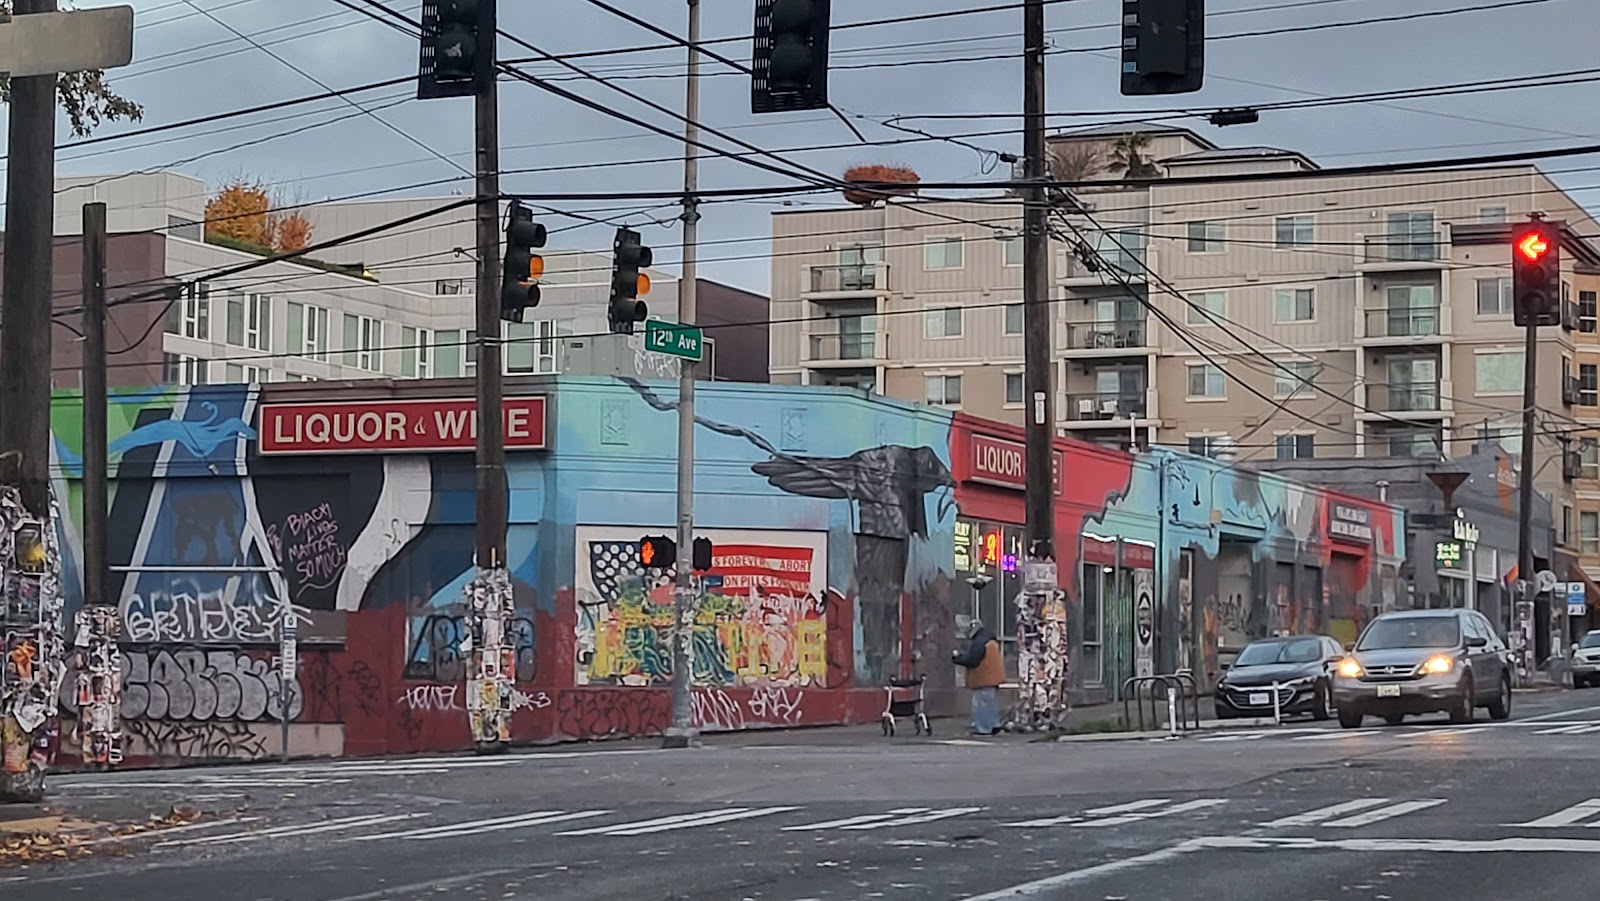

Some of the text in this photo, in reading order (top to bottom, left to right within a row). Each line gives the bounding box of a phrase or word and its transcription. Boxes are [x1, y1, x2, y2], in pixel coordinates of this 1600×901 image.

[652, 327, 697, 350] 12th Ave
[274, 412, 406, 443] LIQUOR
[434, 408, 530, 440] WIE
[976, 444, 1022, 477] LIQUOR
[288, 535, 338, 562] MATTER
[723, 557, 766, 567] FOREVER
[724, 576, 738, 586] ON
[740, 576, 768, 586] PILLS
